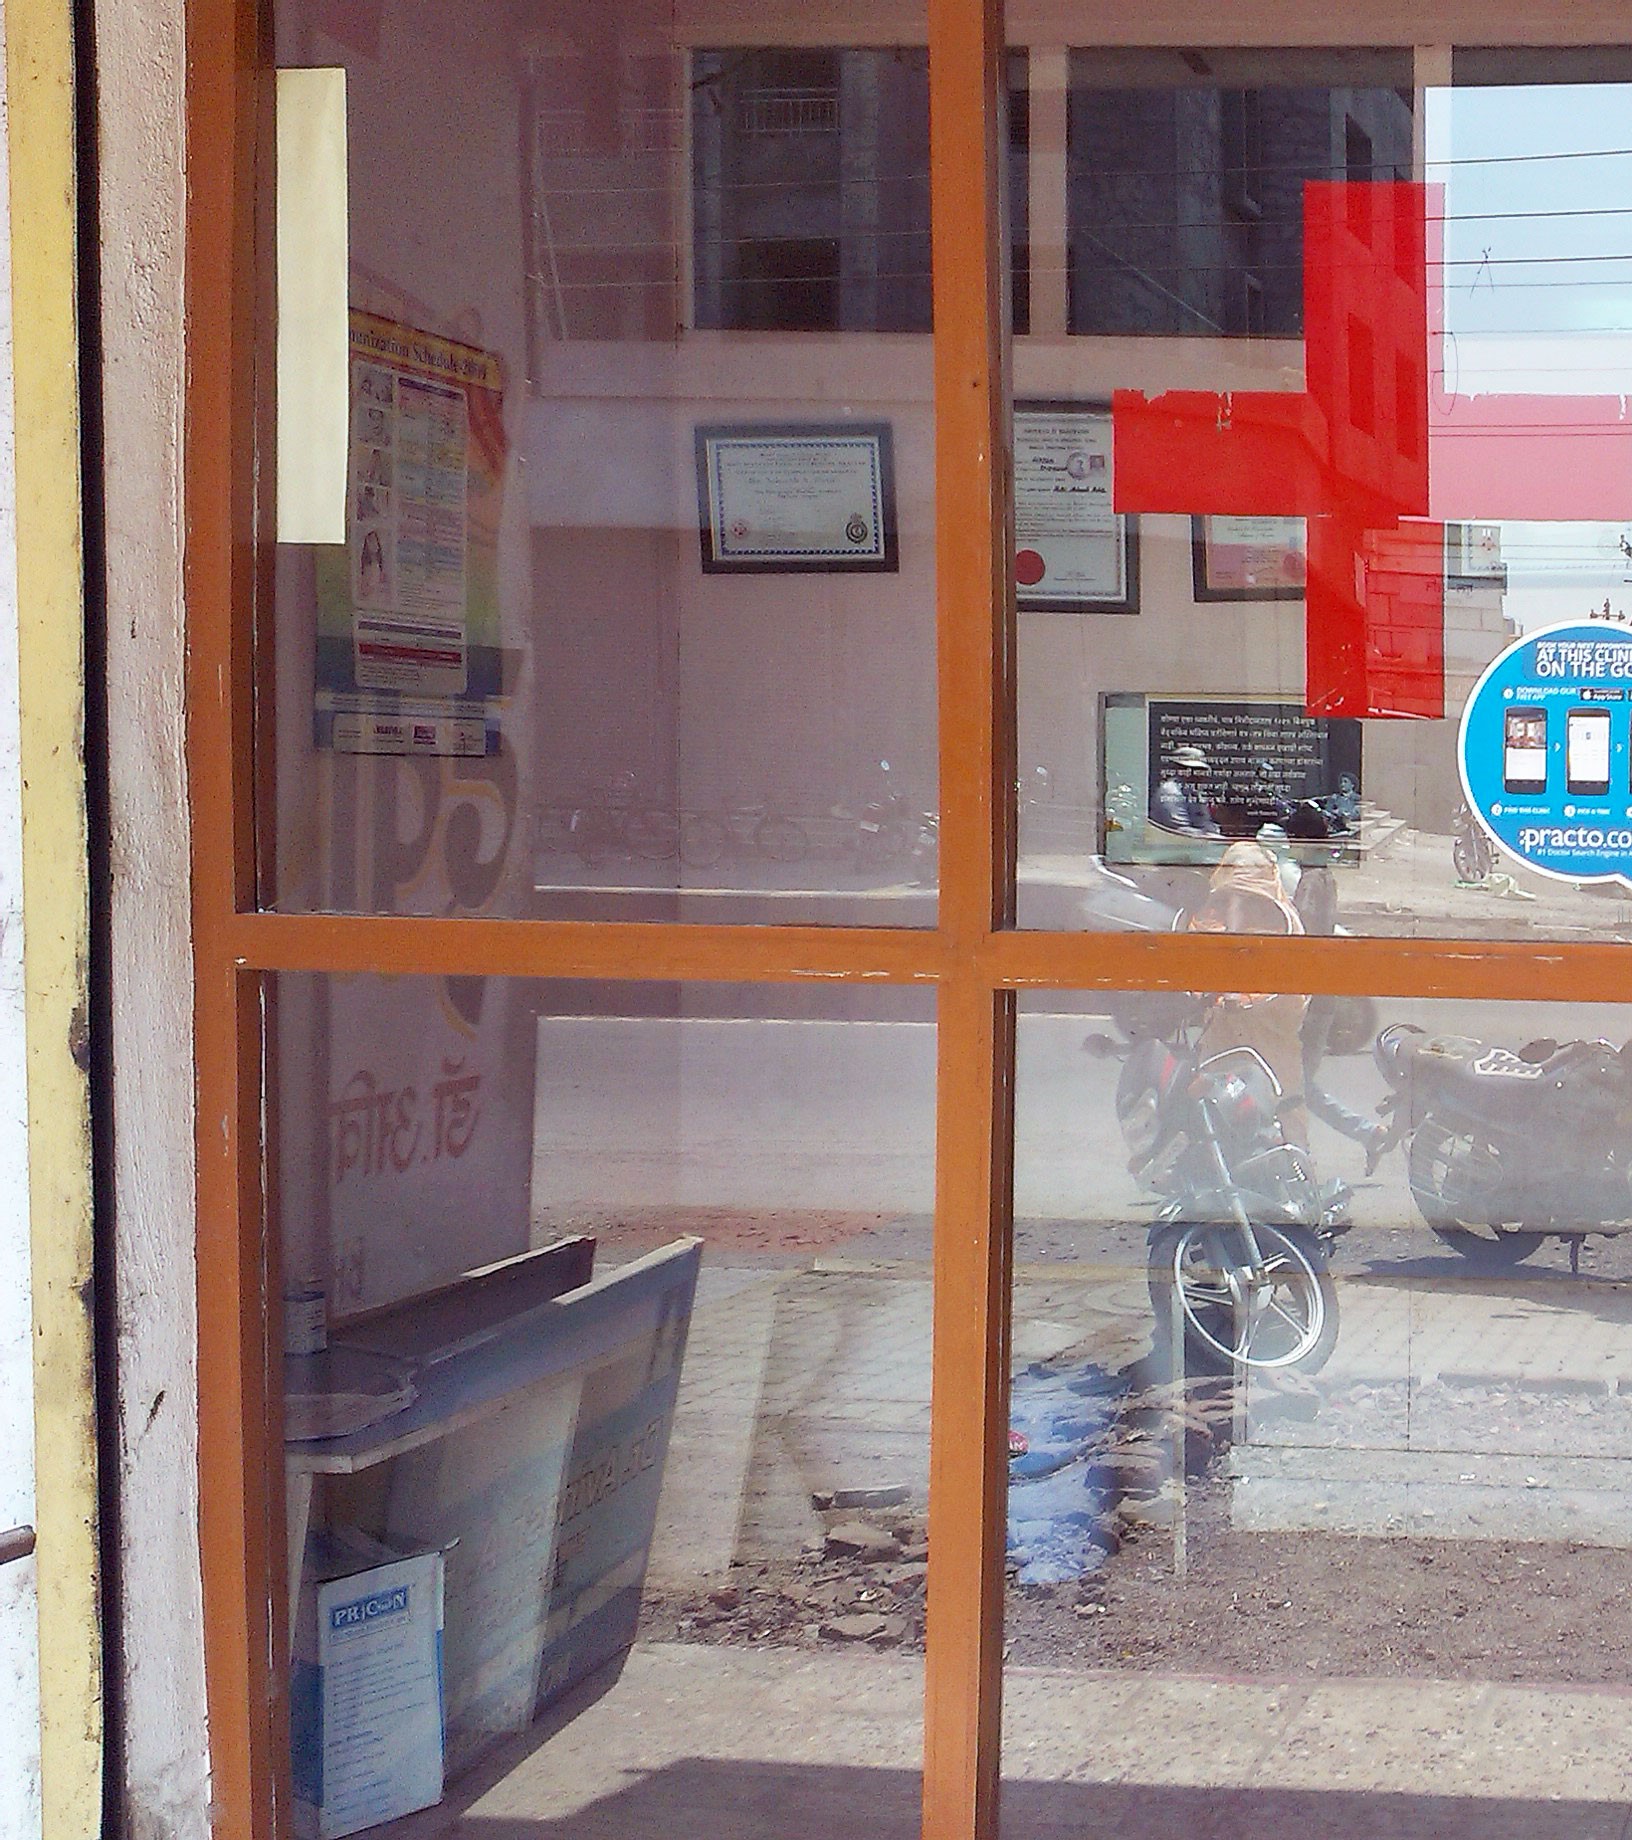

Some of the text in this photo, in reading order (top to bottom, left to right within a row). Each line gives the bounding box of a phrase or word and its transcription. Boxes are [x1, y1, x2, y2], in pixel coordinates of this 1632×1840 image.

[1537, 649, 1556, 662] AT
[1559, 649, 1593, 662] THIS
[1536, 661, 1566, 677] ON
[1570, 661, 1606, 677] THE
